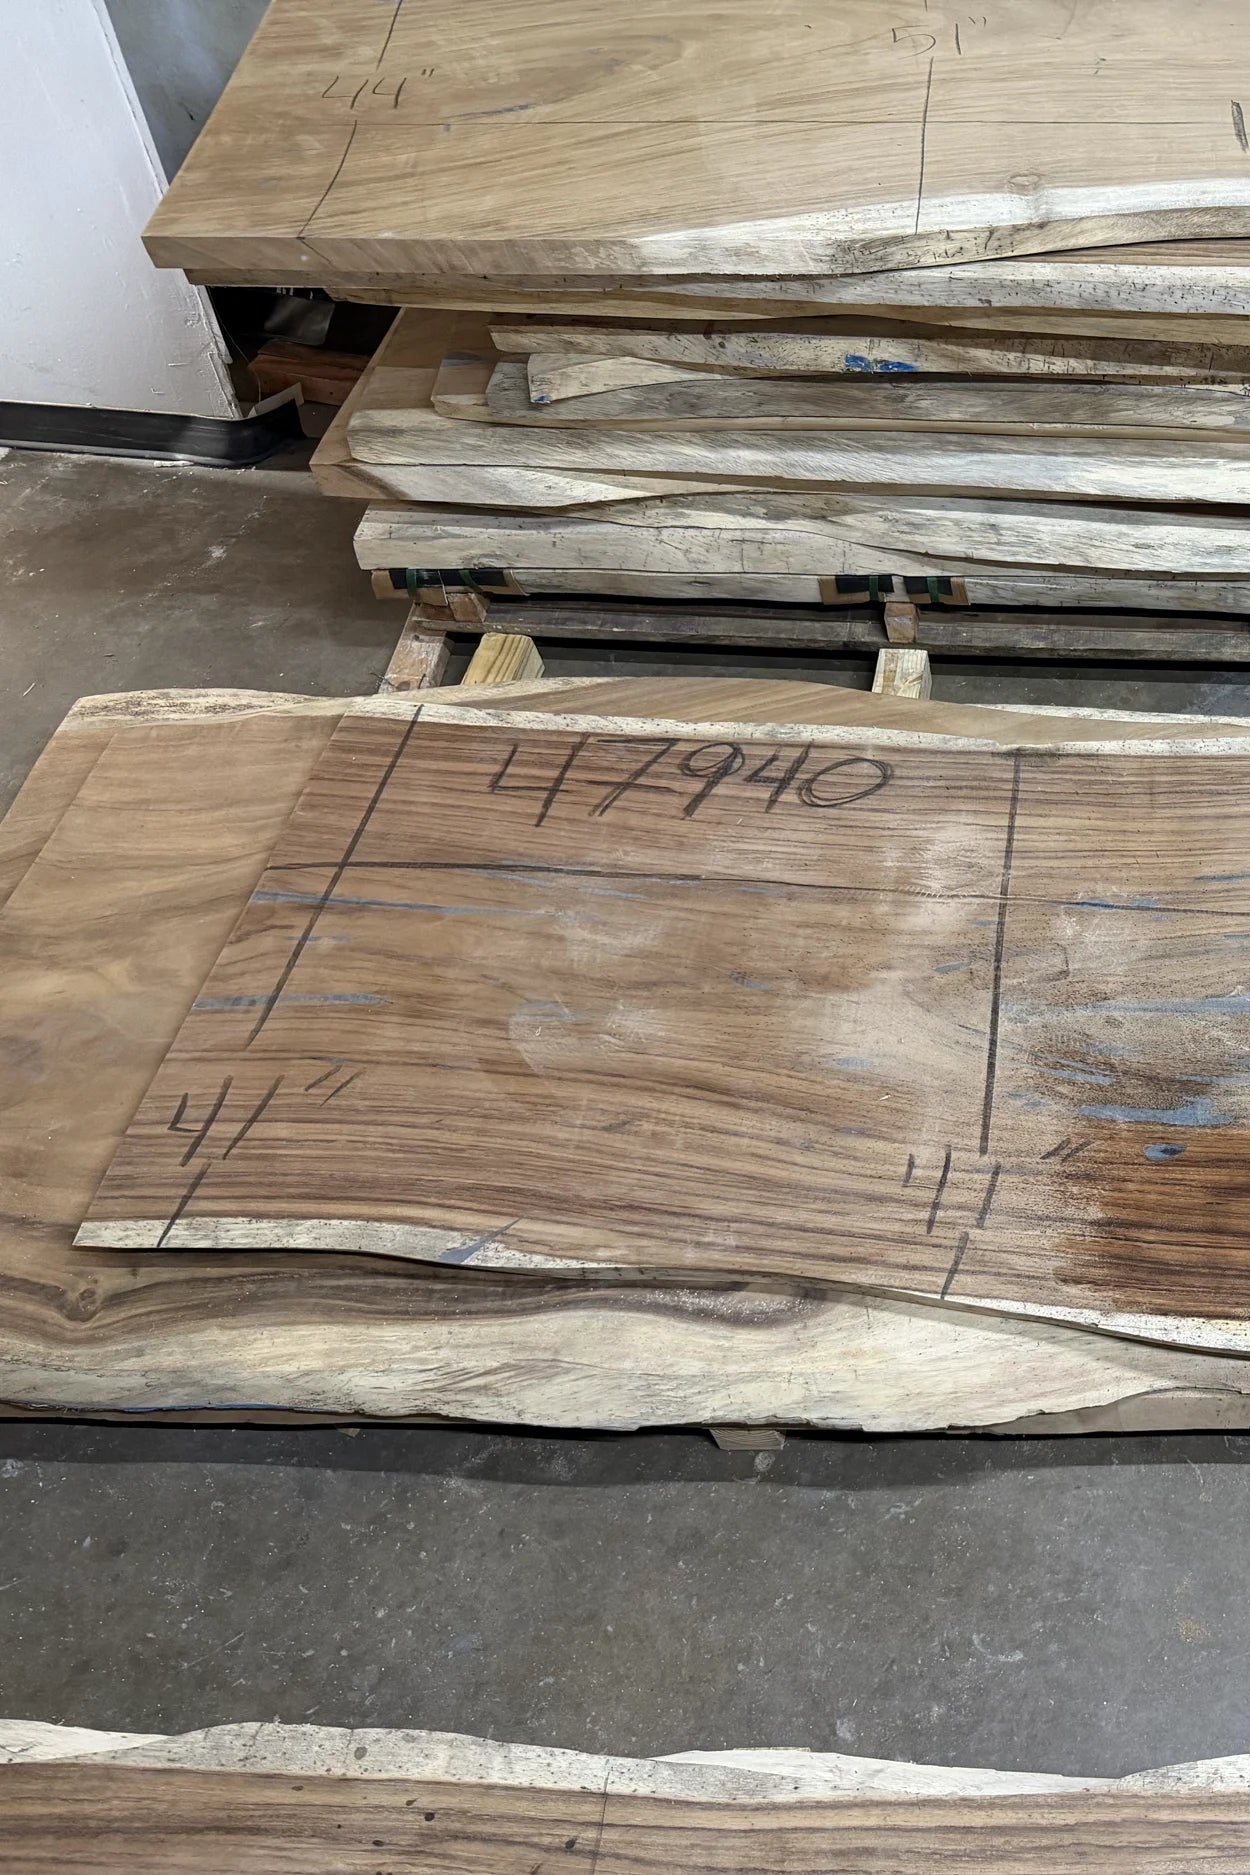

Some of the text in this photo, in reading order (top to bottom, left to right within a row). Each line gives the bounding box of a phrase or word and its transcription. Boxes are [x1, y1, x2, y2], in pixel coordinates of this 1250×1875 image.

[889, 14, 988, 60] 51"
[320, 67, 436, 110] 44"
[486, 732, 894, 828] 47940
[167, 1062, 369, 1168] 41"
